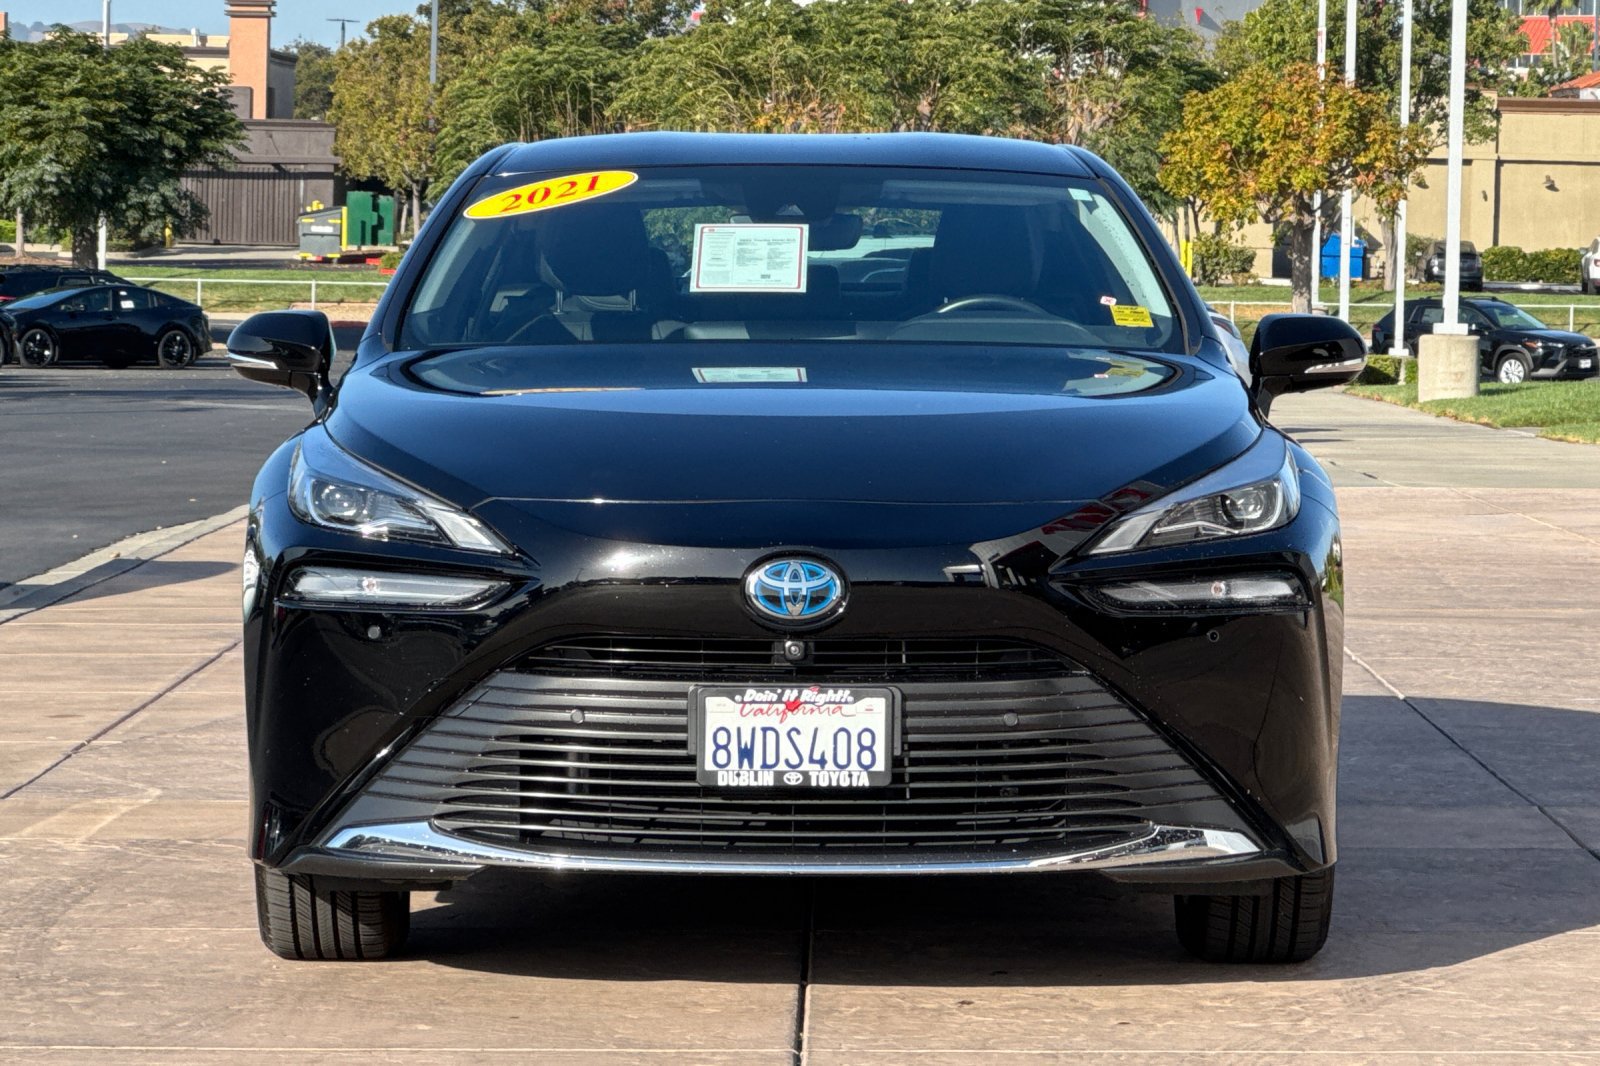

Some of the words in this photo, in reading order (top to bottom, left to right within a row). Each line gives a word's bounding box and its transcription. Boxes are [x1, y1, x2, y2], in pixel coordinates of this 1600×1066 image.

[500, 175, 602, 213] 2021
[743, 688, 782, 702] Doin'
[782, 689, 799, 702] It
[800, 689, 851, 706] Right!
[711, 726, 877, 770] 8WDS408
[717, 770, 775, 786] DUBLIN
[809, 771, 870, 787] TOYOTA
